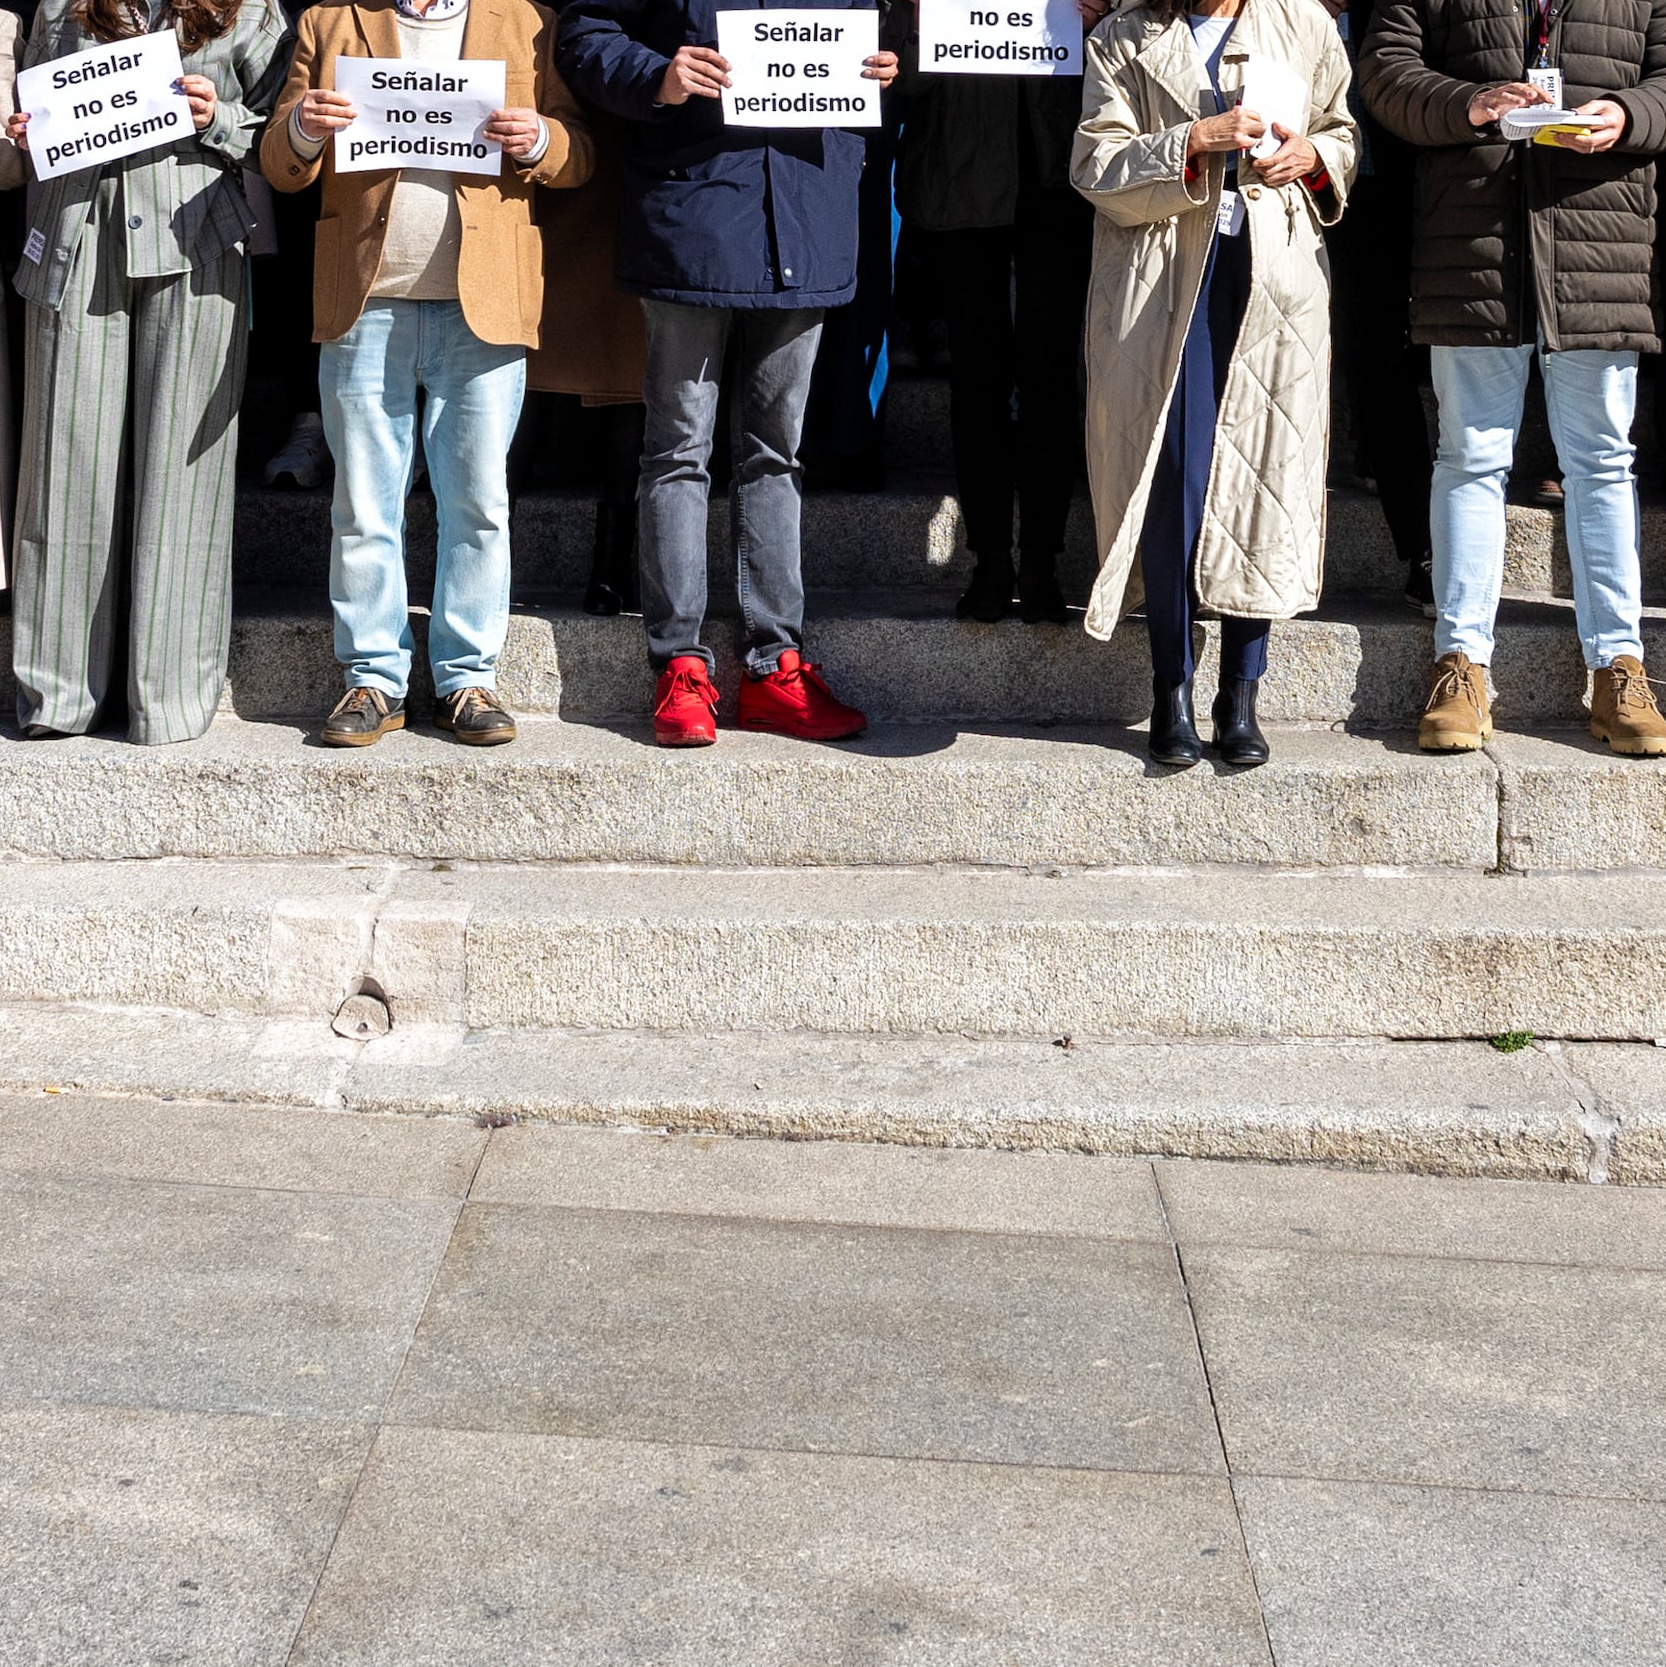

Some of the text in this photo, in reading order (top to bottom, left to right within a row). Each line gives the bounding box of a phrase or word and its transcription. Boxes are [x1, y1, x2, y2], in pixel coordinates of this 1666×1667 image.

[969, 10, 1033, 28] no es
[754, 21, 845, 43] Señalar
[934, 39, 1069, 62] periodismo
[52, 52, 143, 90] Señalar
[371, 71, 469, 93] Señalar
[767, 62, 830, 79] no es
[72, 90, 138, 120] no es
[734, 92, 866, 116] periodismo
[386, 109, 453, 125] no es
[45, 111, 179, 166] periodismo
[349, 136, 488, 161] periodismo
